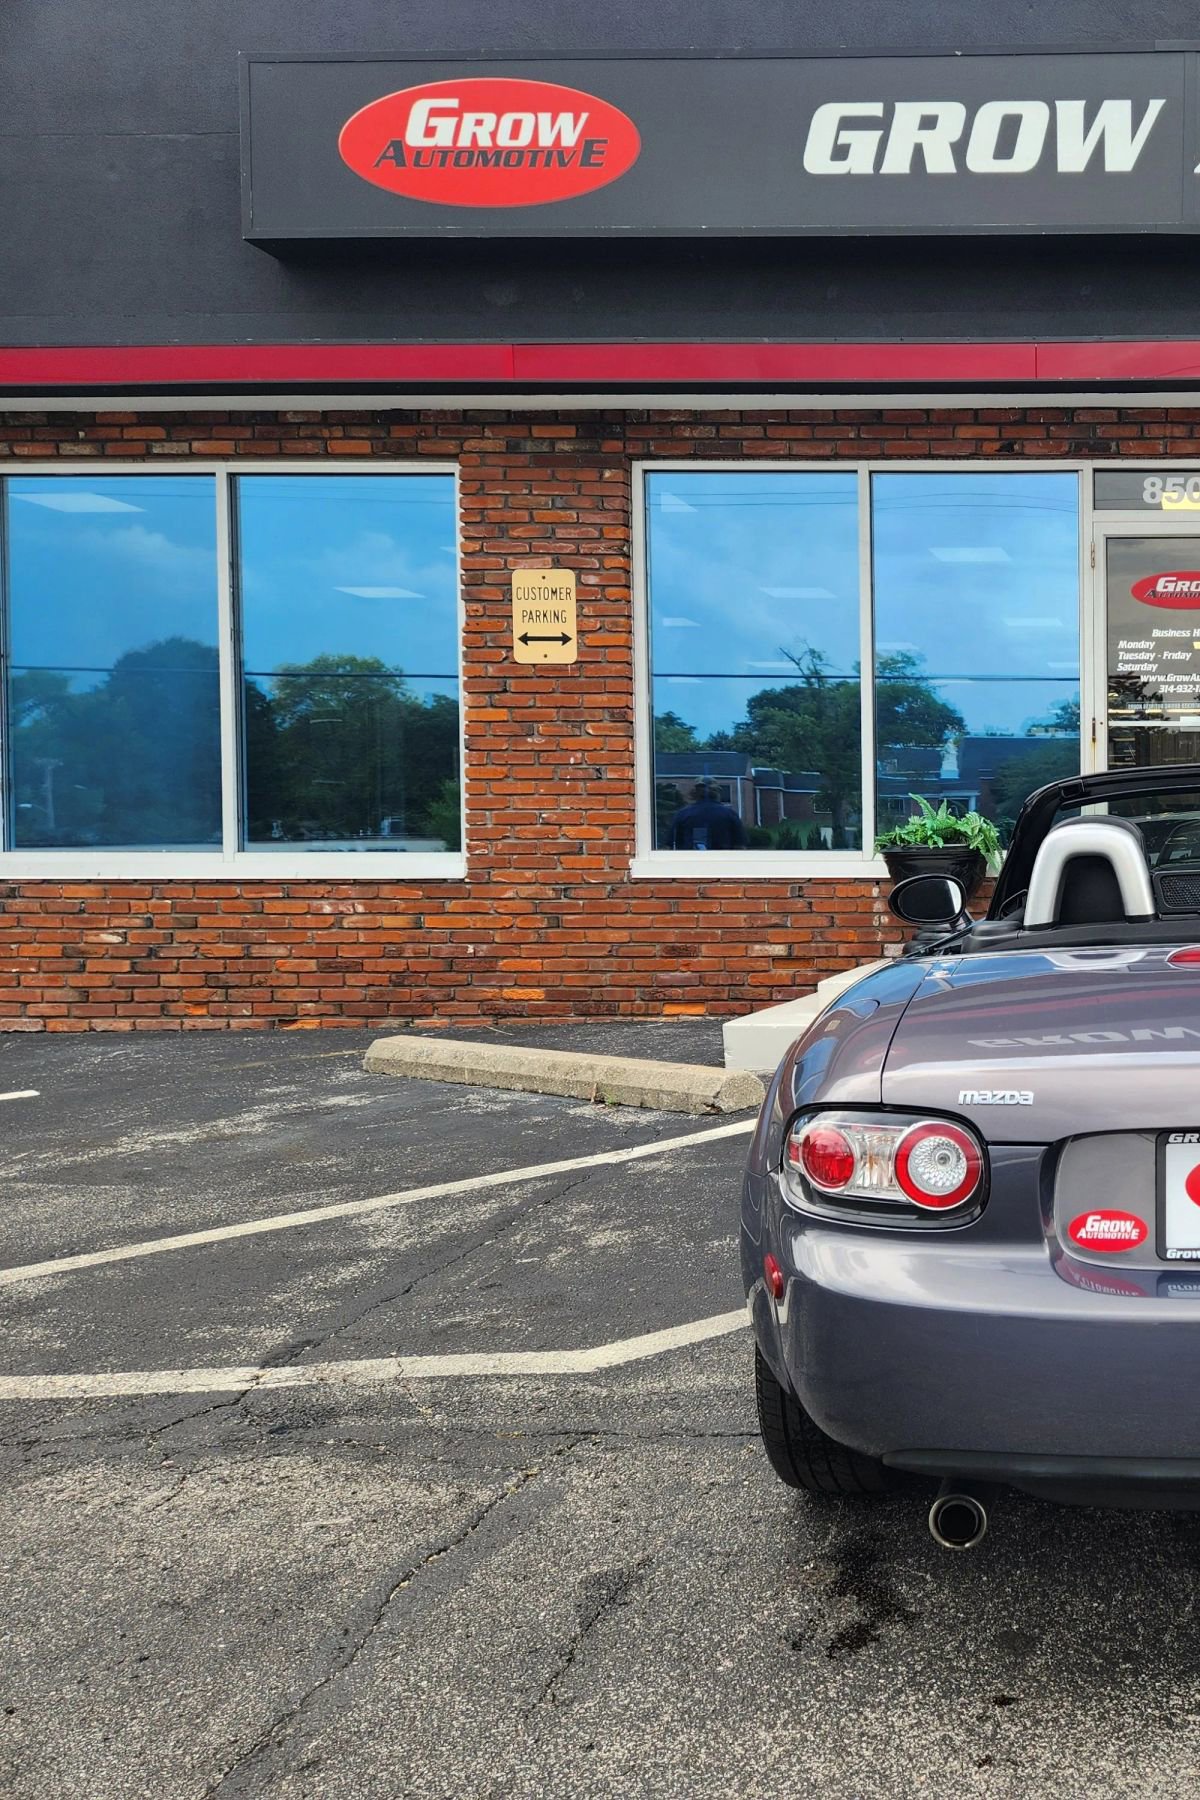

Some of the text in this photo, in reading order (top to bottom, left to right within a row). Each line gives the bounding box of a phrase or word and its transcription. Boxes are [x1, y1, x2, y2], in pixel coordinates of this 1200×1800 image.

[405, 98, 589, 147] GROW
[804, 99, 1166, 174] GROW
[373, 139, 608, 168] AUTOMOTIVE
[516, 587, 572, 601] CUSTOMER
[521, 609, 567, 624] PARKING
[1152, 629, 1191, 638] Business
[1118, 640, 1155, 650] Monday
[1118, 651, 1156, 661] Tuesday
[1163, 651, 1192, 661] Friday
[1117, 662, 1158, 672] Saturday
